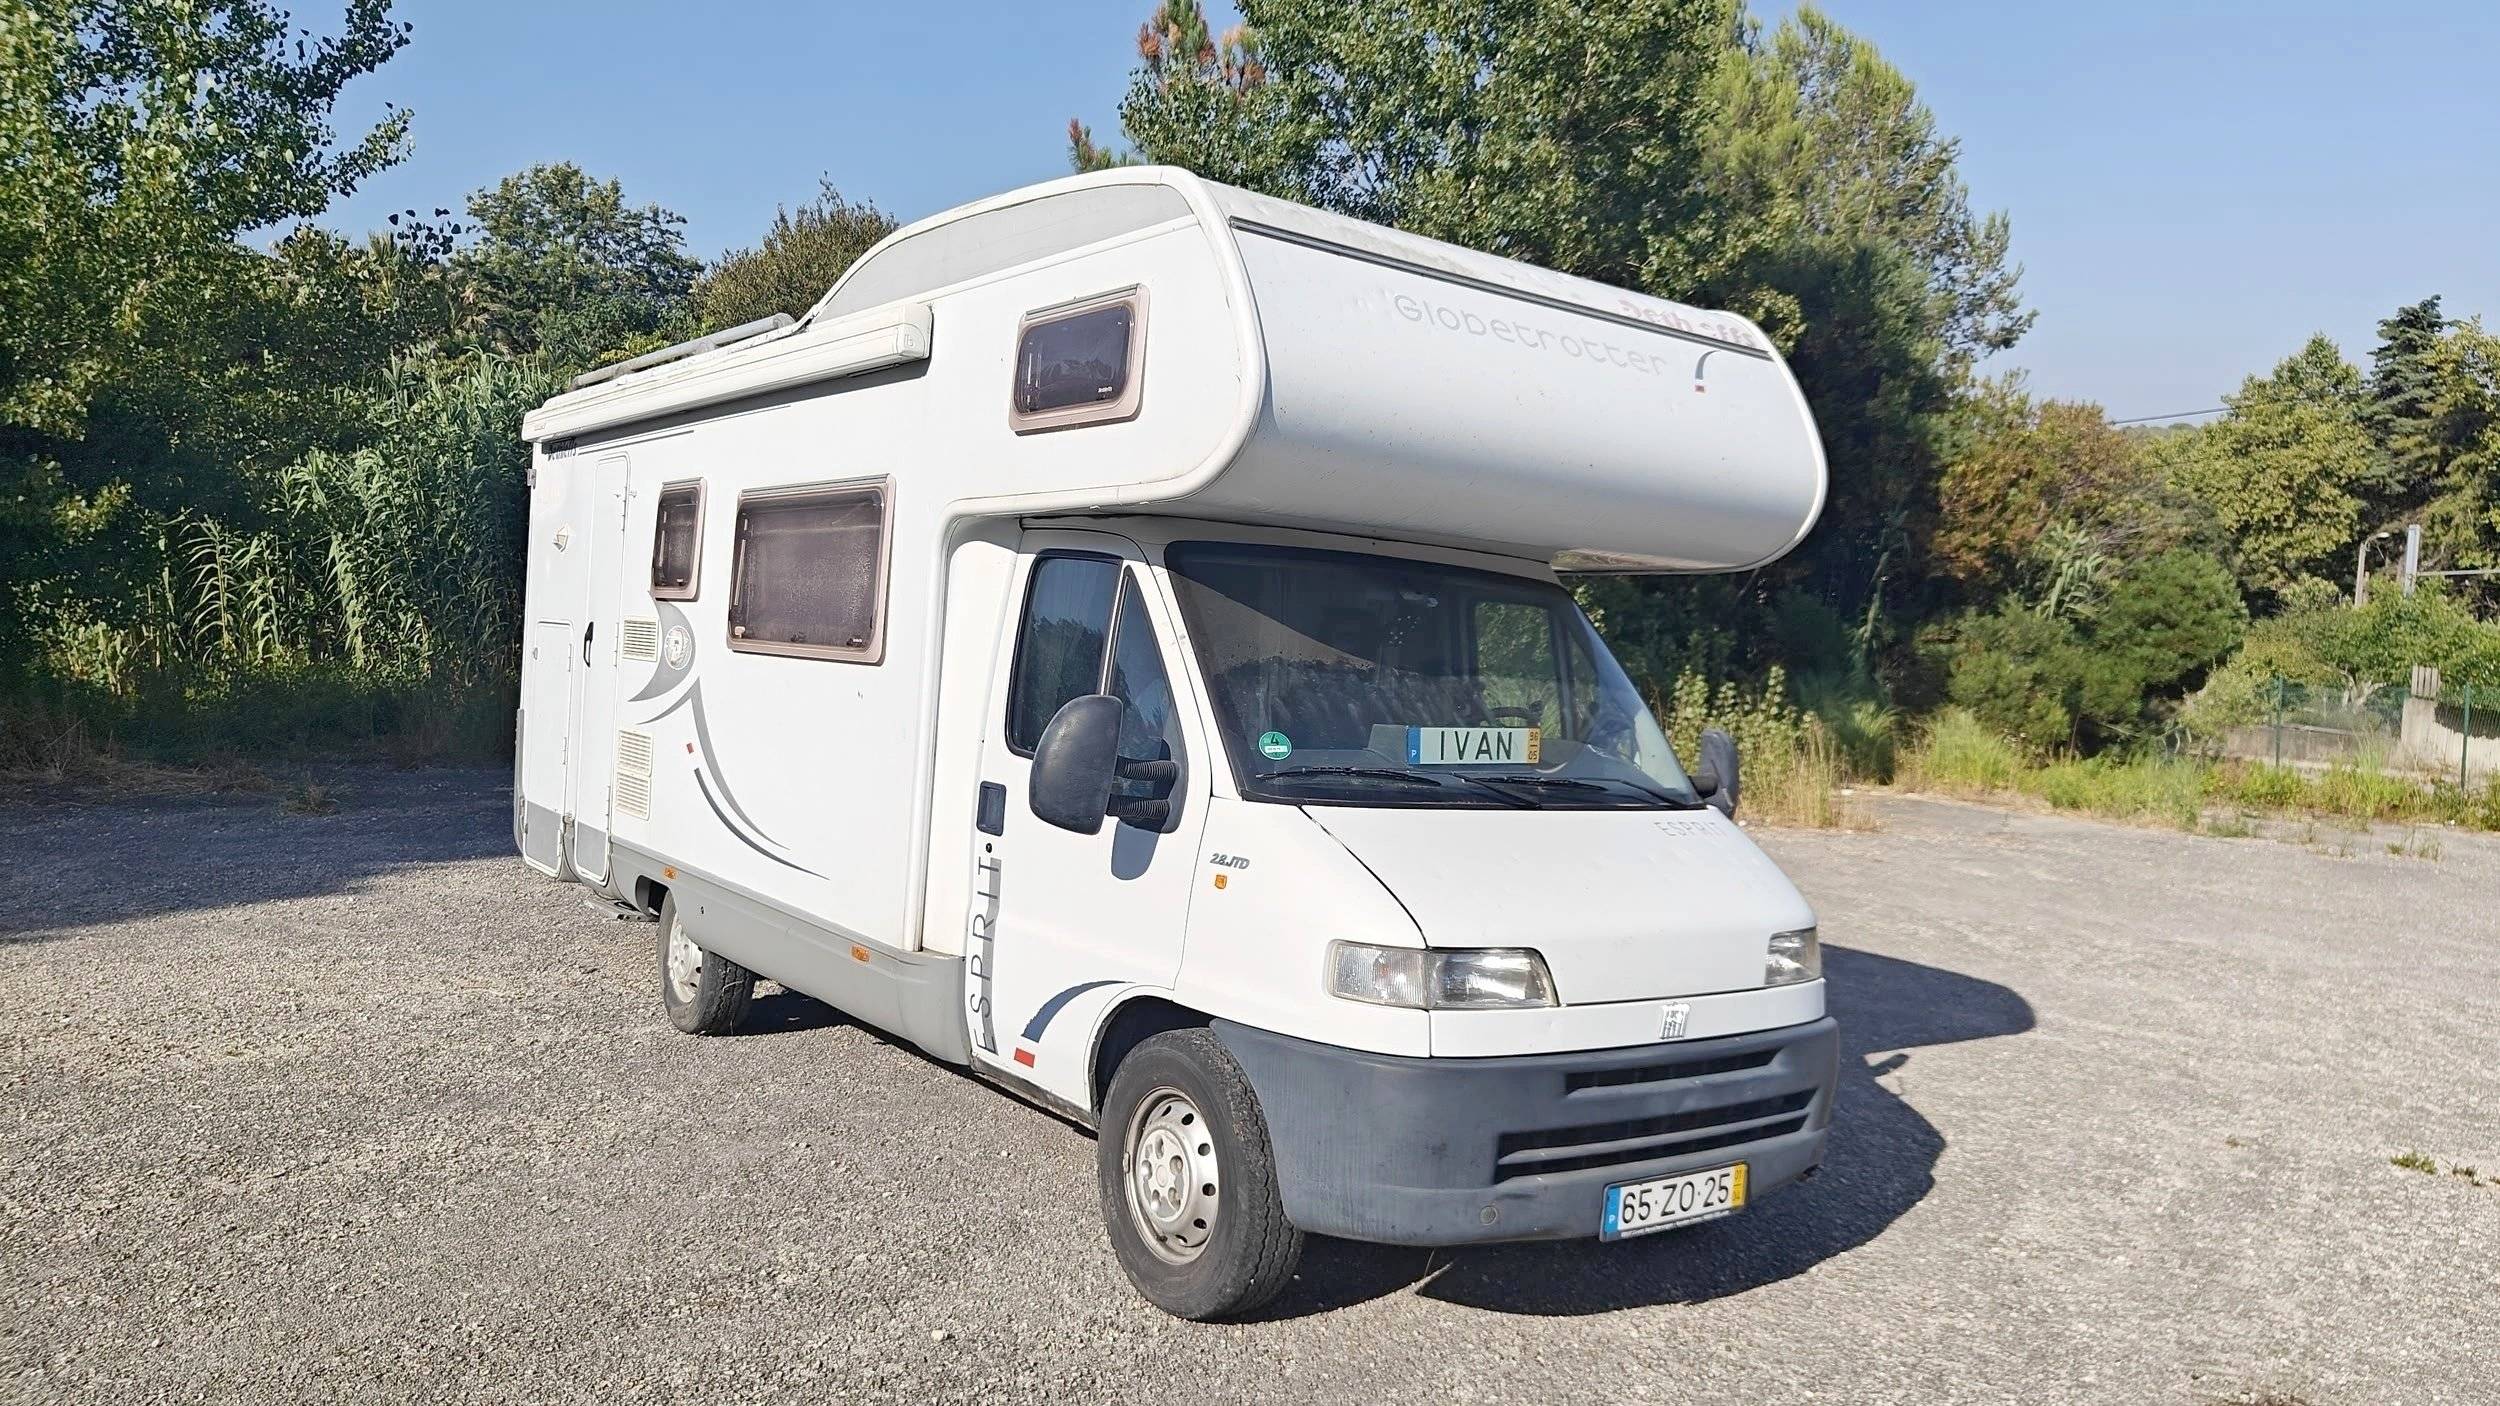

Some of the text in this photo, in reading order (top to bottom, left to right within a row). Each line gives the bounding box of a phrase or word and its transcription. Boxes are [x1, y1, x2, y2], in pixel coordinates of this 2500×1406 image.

[1393, 293, 1668, 376] Globetrotter
[1270, 733, 1280, 746] 4
[1439, 730, 1513, 761] IVAN
[1411, 749, 1417, 758] P
[970, 856, 999, 1056] ESPRIT
[1608, 1214, 1616, 1224] P
